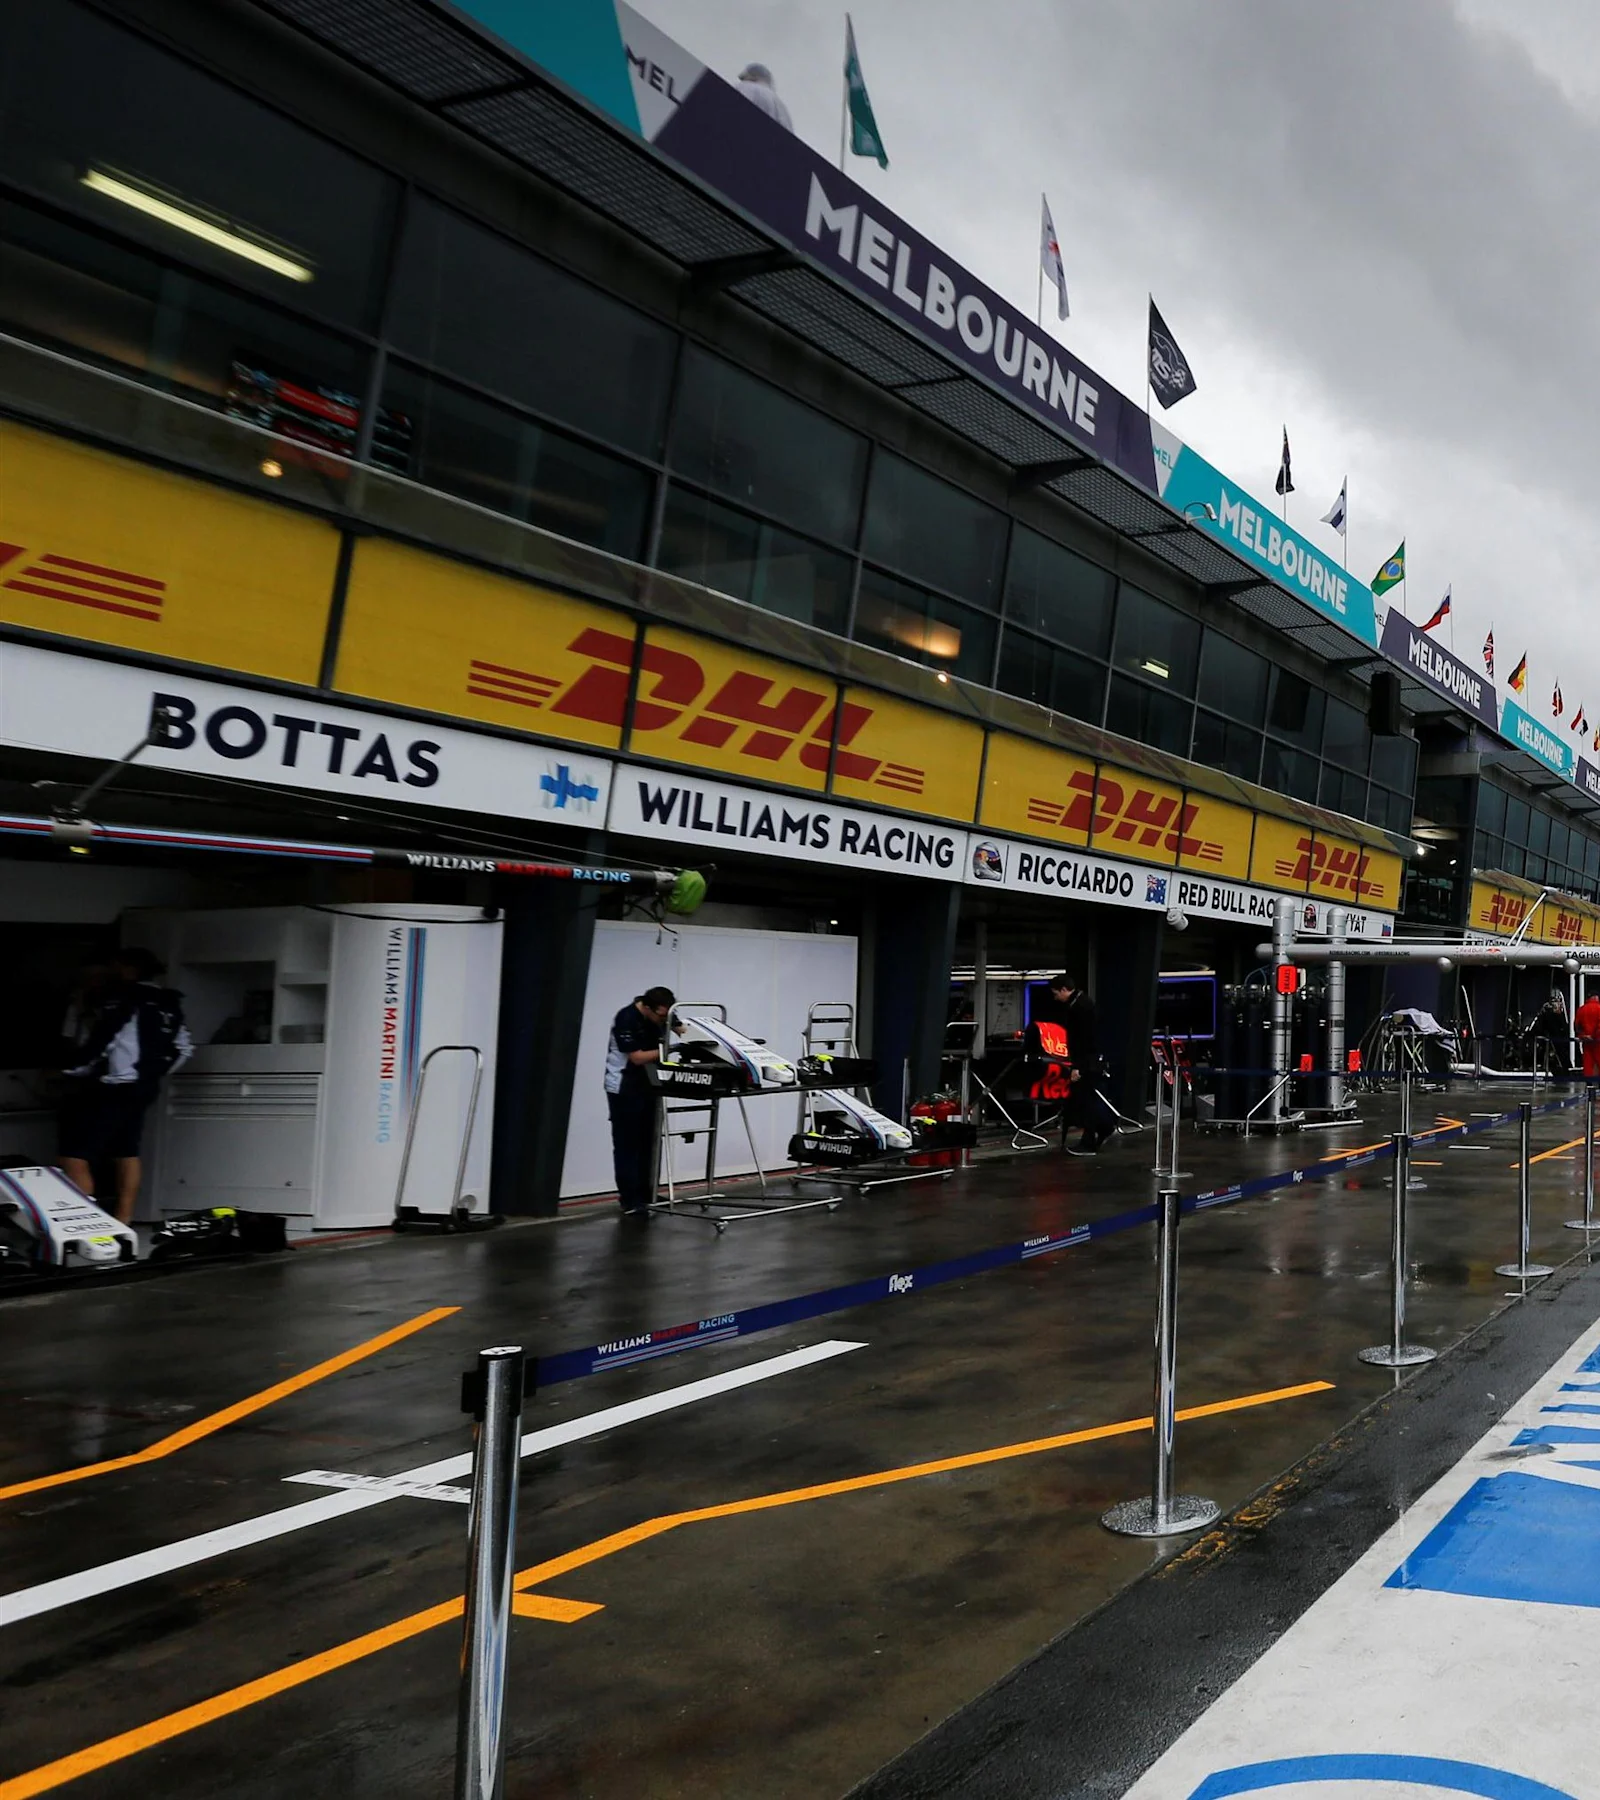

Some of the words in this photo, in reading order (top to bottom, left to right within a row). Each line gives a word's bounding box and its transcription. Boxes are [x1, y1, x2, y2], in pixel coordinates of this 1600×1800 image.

[806, 172, 1099, 436] MELBOURNE
[1218, 489, 1348, 614] MELBOURNE
[1408, 632, 1482, 709] MELBOURNE
[551, 627, 882, 782] DHL
[152, 692, 442, 788] BOTTAS
[1517, 715, 1564, 768] MELBOURNE
[638, 781, 829, 849] WILLIAMS
[840, 819, 955, 868] RACING
[1059, 770, 1203, 857] DHL
[406, 853, 496, 872] WILLIAMS
[496, 862, 573, 879] MARTINI
[573, 867, 631, 883] RACING
[1018, 852, 1134, 899] RICCIARDO
[1294, 837, 1375, 895] DHL
[1178, 881, 1207, 910] RED
[1211, 888, 1245, 915] BULL
[1489, 894, 1531, 929] DHL
[1555, 913, 1584, 942] DHL
[384, 927, 402, 1004] WILLIAMS
[379, 1007, 399, 1079] MARTINI
[674, 1071, 713, 1085] WIHURI
[375, 1082, 393, 1143] RACING
[818, 1141, 853, 1155] WIHURI
[62, 1222, 114, 1234] ORIS
[1024, 1234, 1050, 1248] WILLIAMS
[597, 1333, 652, 1355] WILLIAMS
[698, 1313, 736, 1331] RACING
